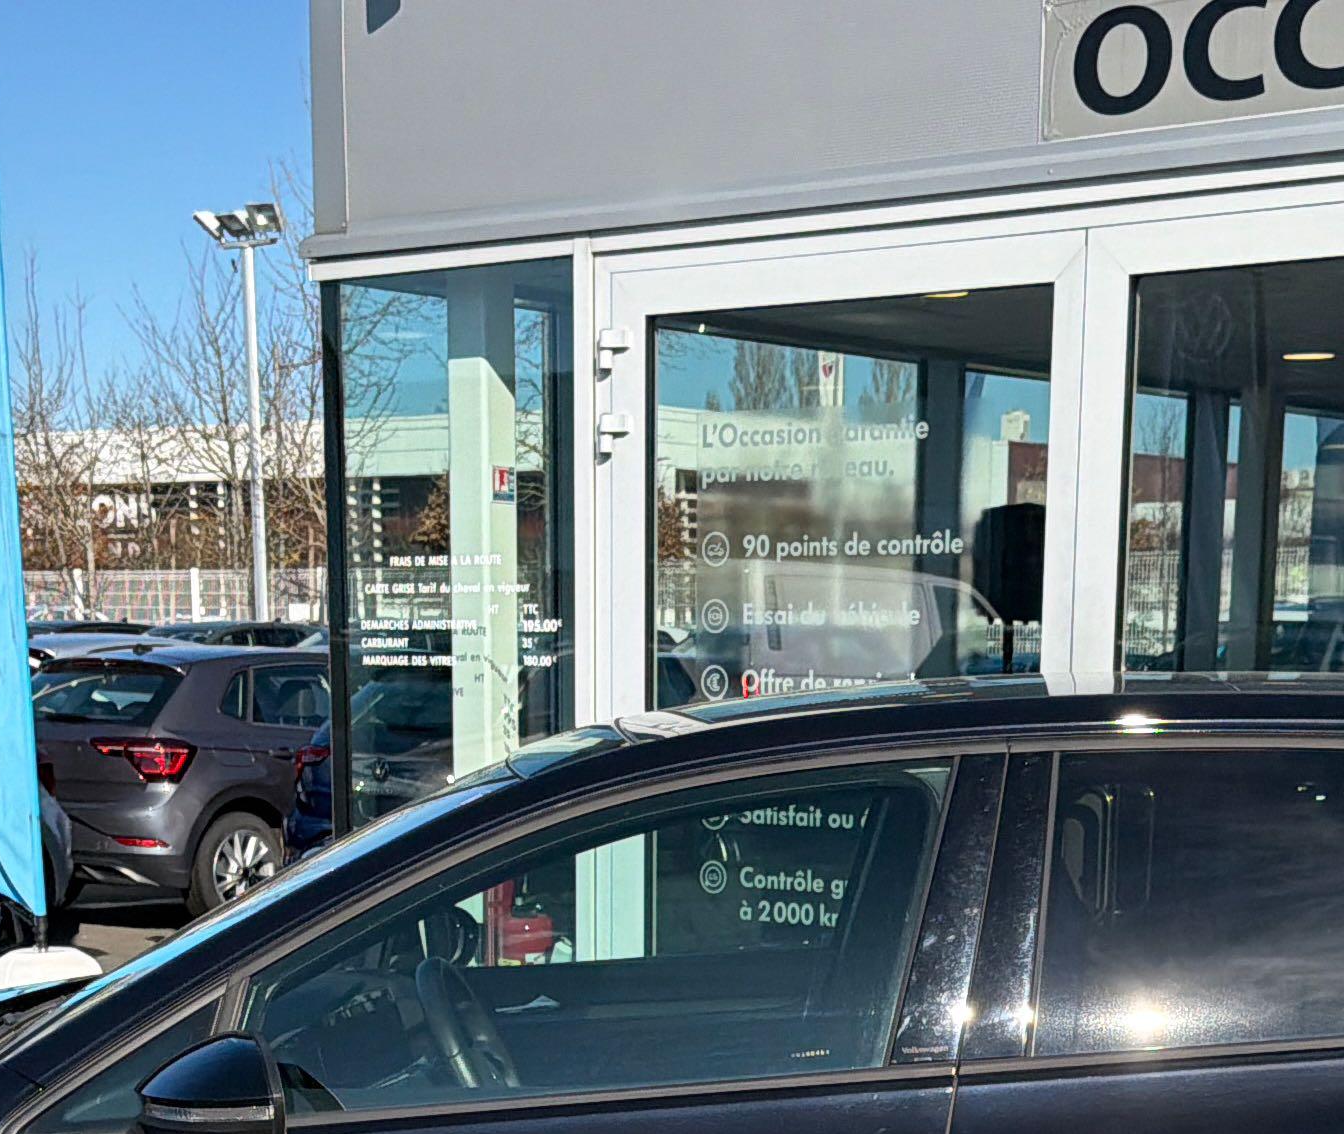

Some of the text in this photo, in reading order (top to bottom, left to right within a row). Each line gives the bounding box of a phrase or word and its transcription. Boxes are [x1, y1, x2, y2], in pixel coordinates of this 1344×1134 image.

[836, 413, 930, 440] arantie
[701, 459, 895, 490] par notre reau.
[742, 529, 964, 563] 90 points de contrôle
[389, 555, 412, 567] FRAIS
[414, 555, 425, 567] DE
[428, 555, 449, 566] MISE
[460, 554, 472, 566] LA
[473, 554, 502, 566] ROUTE
[364, 583, 390, 595] CARTE
[392, 583, 415, 595] GRISE
[418, 582, 437, 594] Tarif
[439, 582, 451, 594] du
[522, 603, 539, 616] TTC
[742, 602, 793, 626] Essai
[360, 619, 410, 631] DEMARCHES
[361, 637, 410, 649] CARBURANT
[361, 655, 410, 667] MARQUAGE
[411, 655, 428, 667] DES
[741, 668, 794, 697] Offre
[827, 810, 854, 830] ou
[739, 866, 825, 893] Contrôle
[739, 900, 753, 921] à
